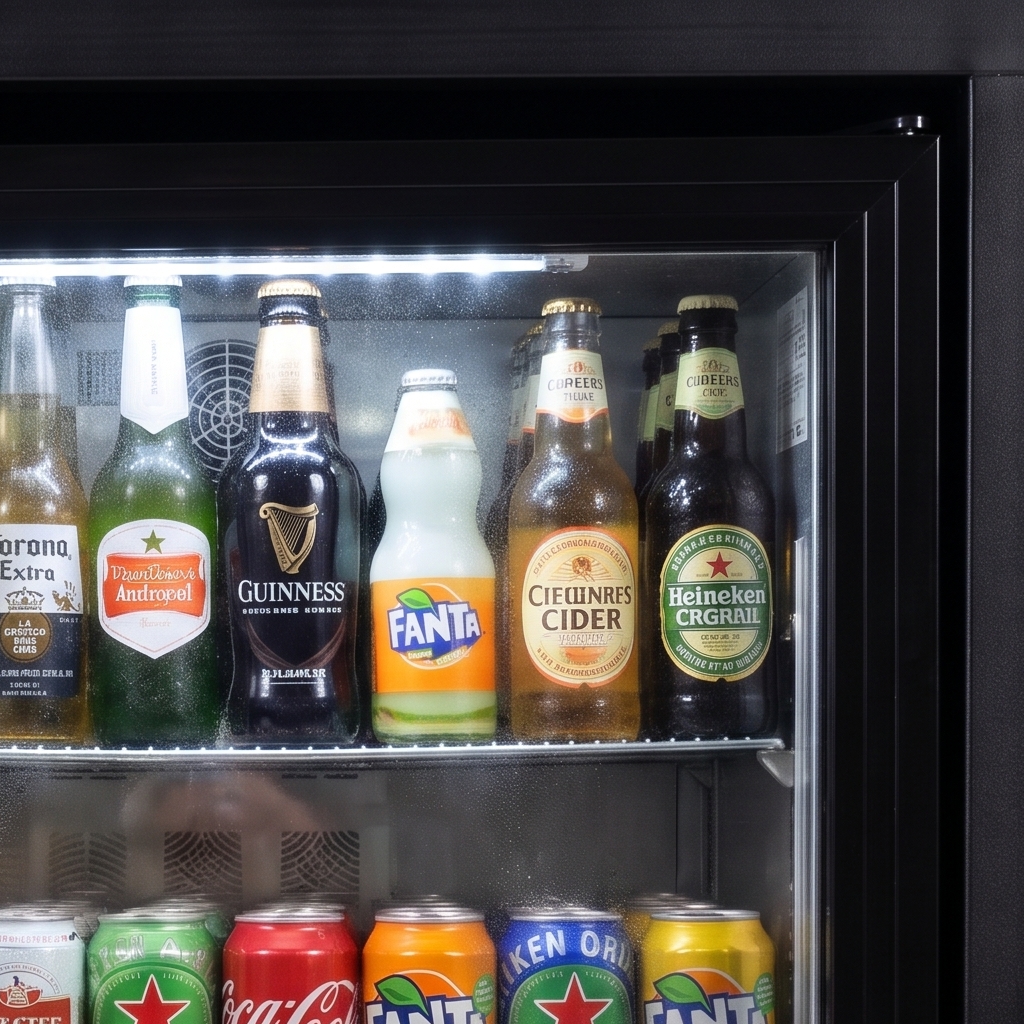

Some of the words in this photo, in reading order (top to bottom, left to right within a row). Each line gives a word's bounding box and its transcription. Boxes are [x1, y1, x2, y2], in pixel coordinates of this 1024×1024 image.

[0, 560, 55, 581] Extra
[238, 580, 345, 603] GUINNESS
[668, 585, 766, 607] Heineken
[388, 603, 481, 648] FANTA
[541, 609, 622, 631] CIDER
